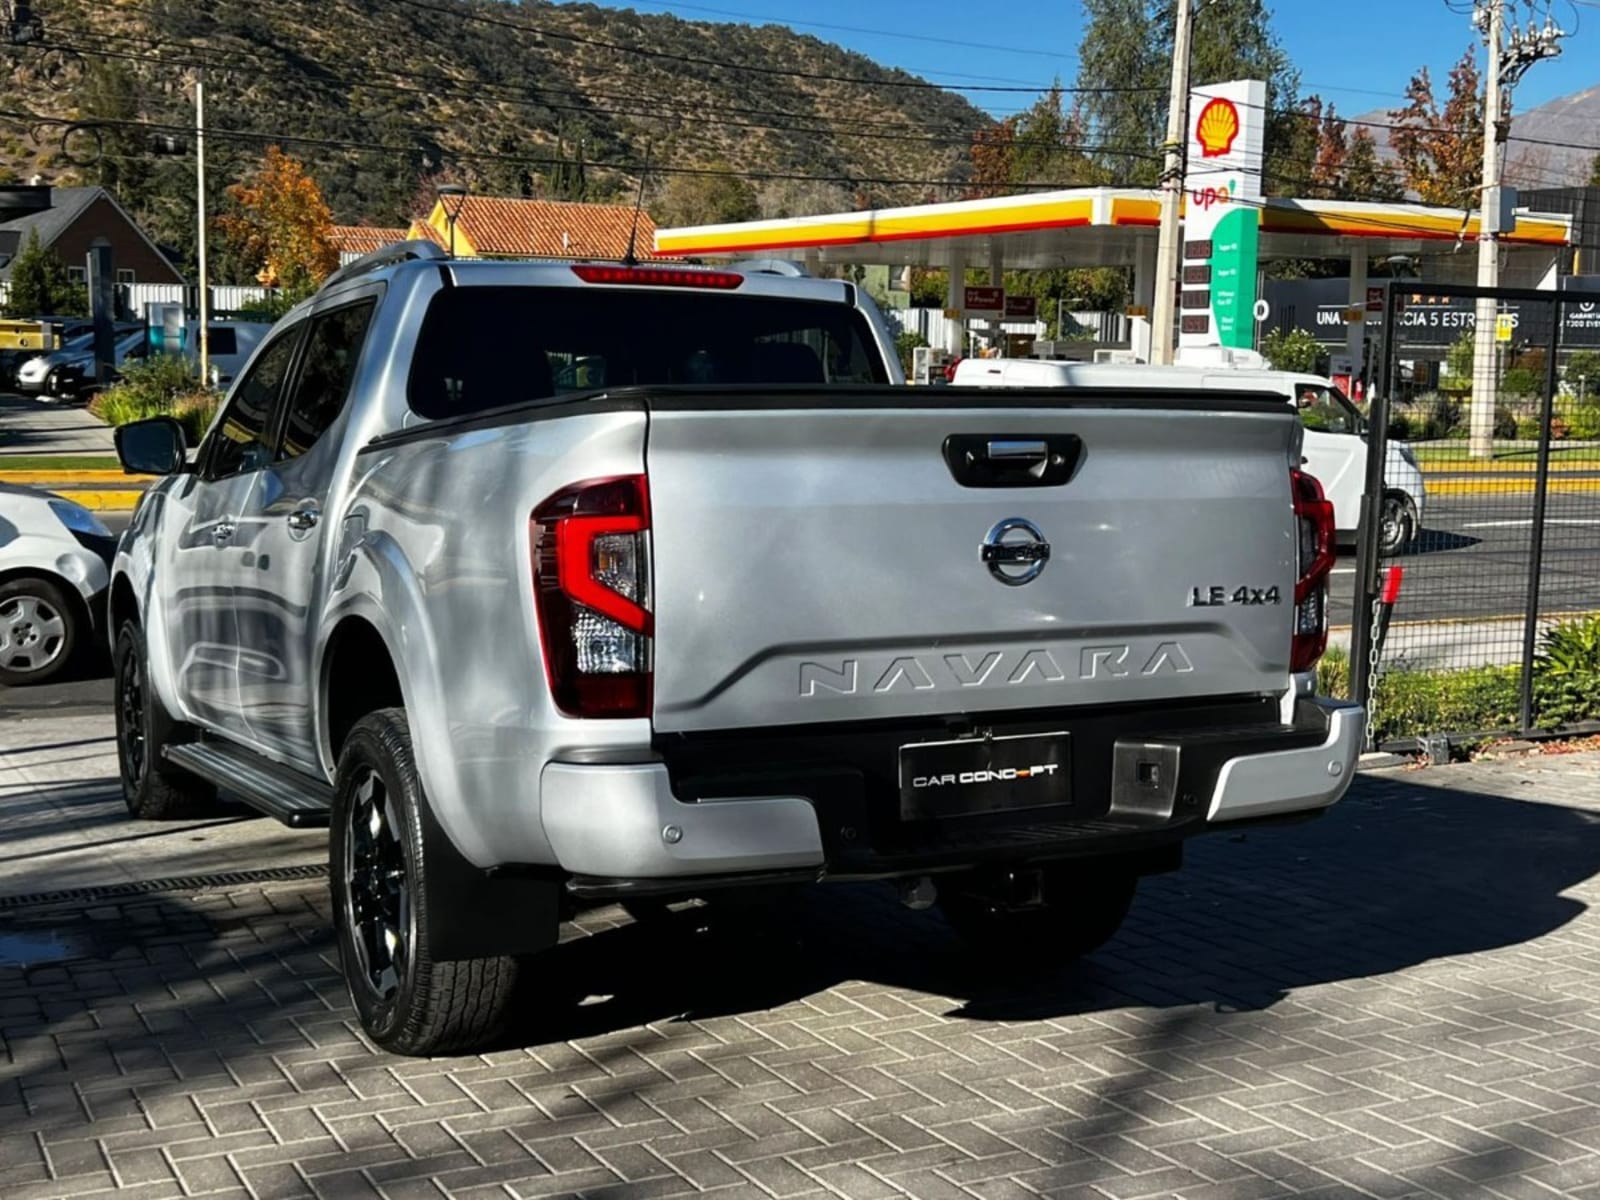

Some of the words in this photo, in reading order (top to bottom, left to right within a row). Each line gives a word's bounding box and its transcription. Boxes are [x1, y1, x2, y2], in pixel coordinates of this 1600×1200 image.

[1316, 311, 1341, 326] UNA
[1429, 312, 1439, 327] 5
[1442, 311, 1519, 328] ESTRS
[1190, 585, 1225, 607] LE
[1229, 584, 1281, 606] 4x4
[799, 641, 1194, 697] NAVARA
[912, 773, 956, 788] CAR
